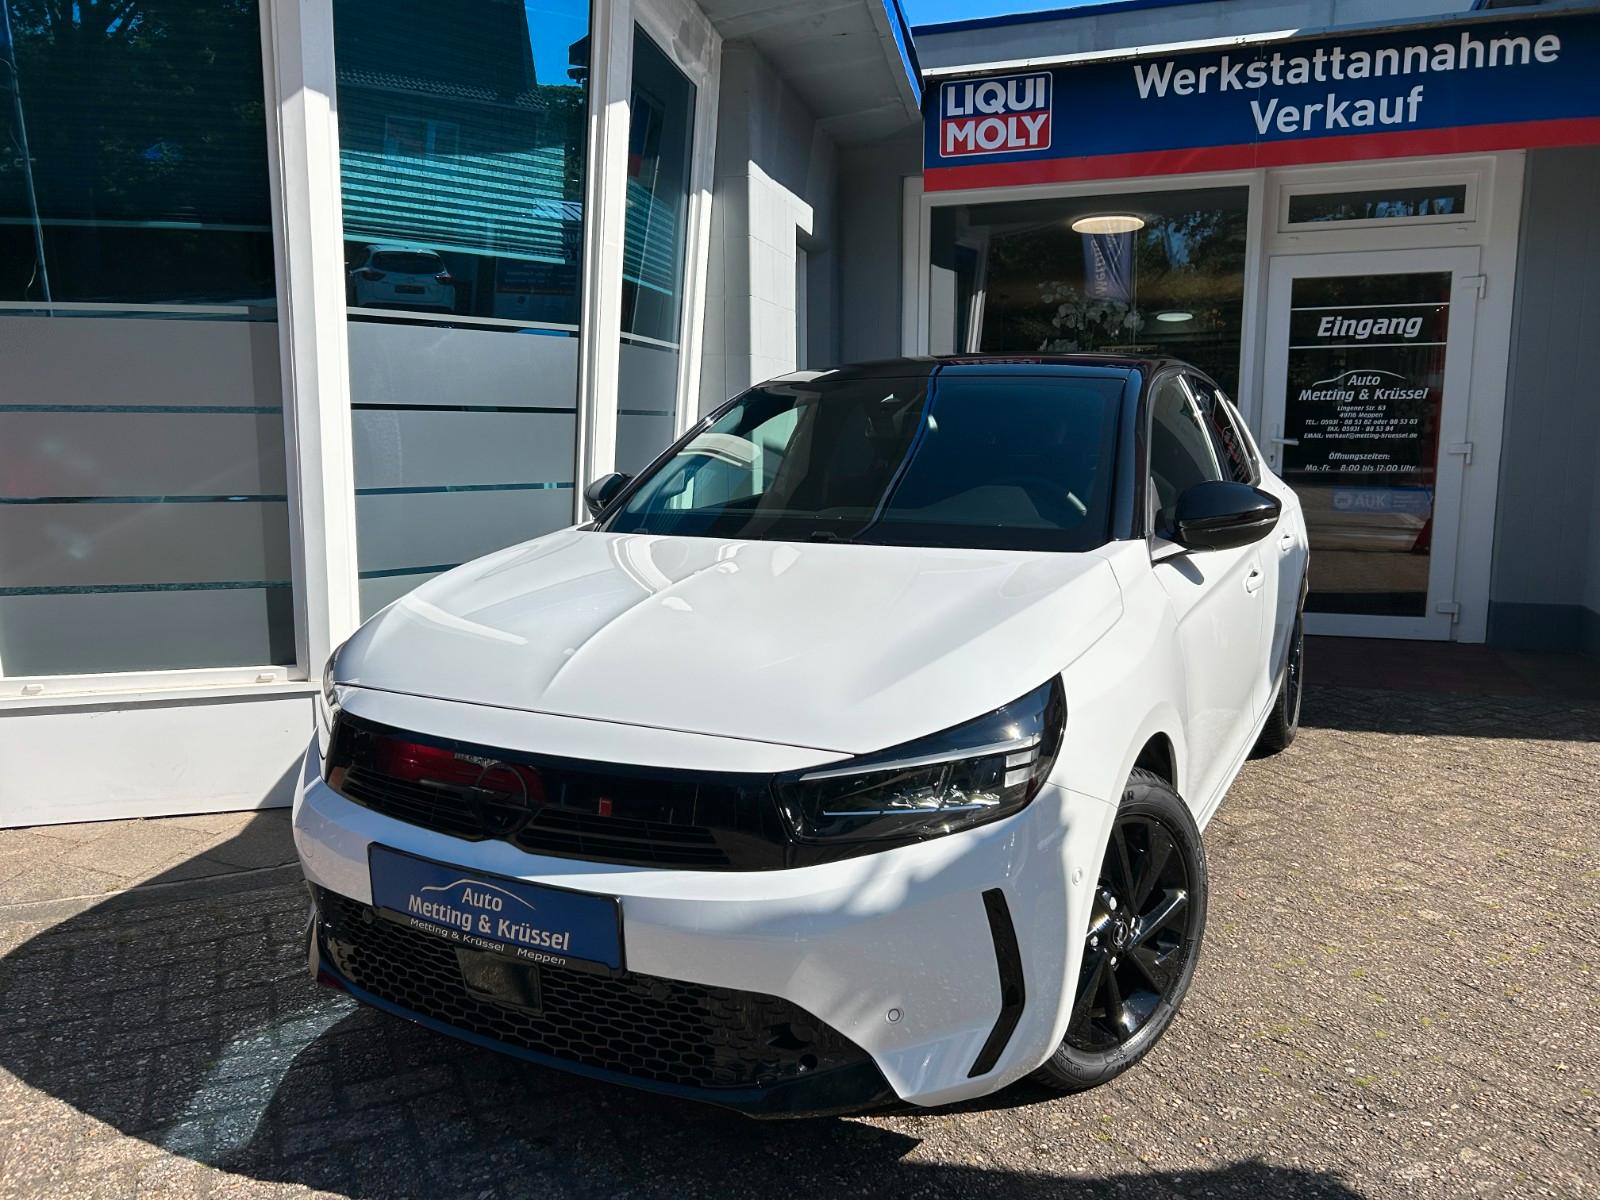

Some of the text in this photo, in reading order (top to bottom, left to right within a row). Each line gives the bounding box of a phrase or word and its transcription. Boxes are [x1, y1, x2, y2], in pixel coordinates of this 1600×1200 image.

[1133, 31, 1561, 99] Werkstattannahme
[946, 77, 1045, 117] LIQUI
[1250, 84, 1424, 135] Verkauf
[946, 113, 1049, 153] MOLY
[1317, 316, 1423, 340] Eingang
[1298, 387, 1430, 402] Metting & Krüssel
[1347, 374, 1381, 386] Auto
[1328, 452, 1390, 461] Öffnungszeiten:
[1362, 464, 1374, 472] bis
[1376, 464, 1398, 472] 17:00
[462, 887, 502, 912] Auto
[408, 894, 570, 951] Metting & Krüssel
[410, 918, 566, 966] Metting & Krüssel Meppen
